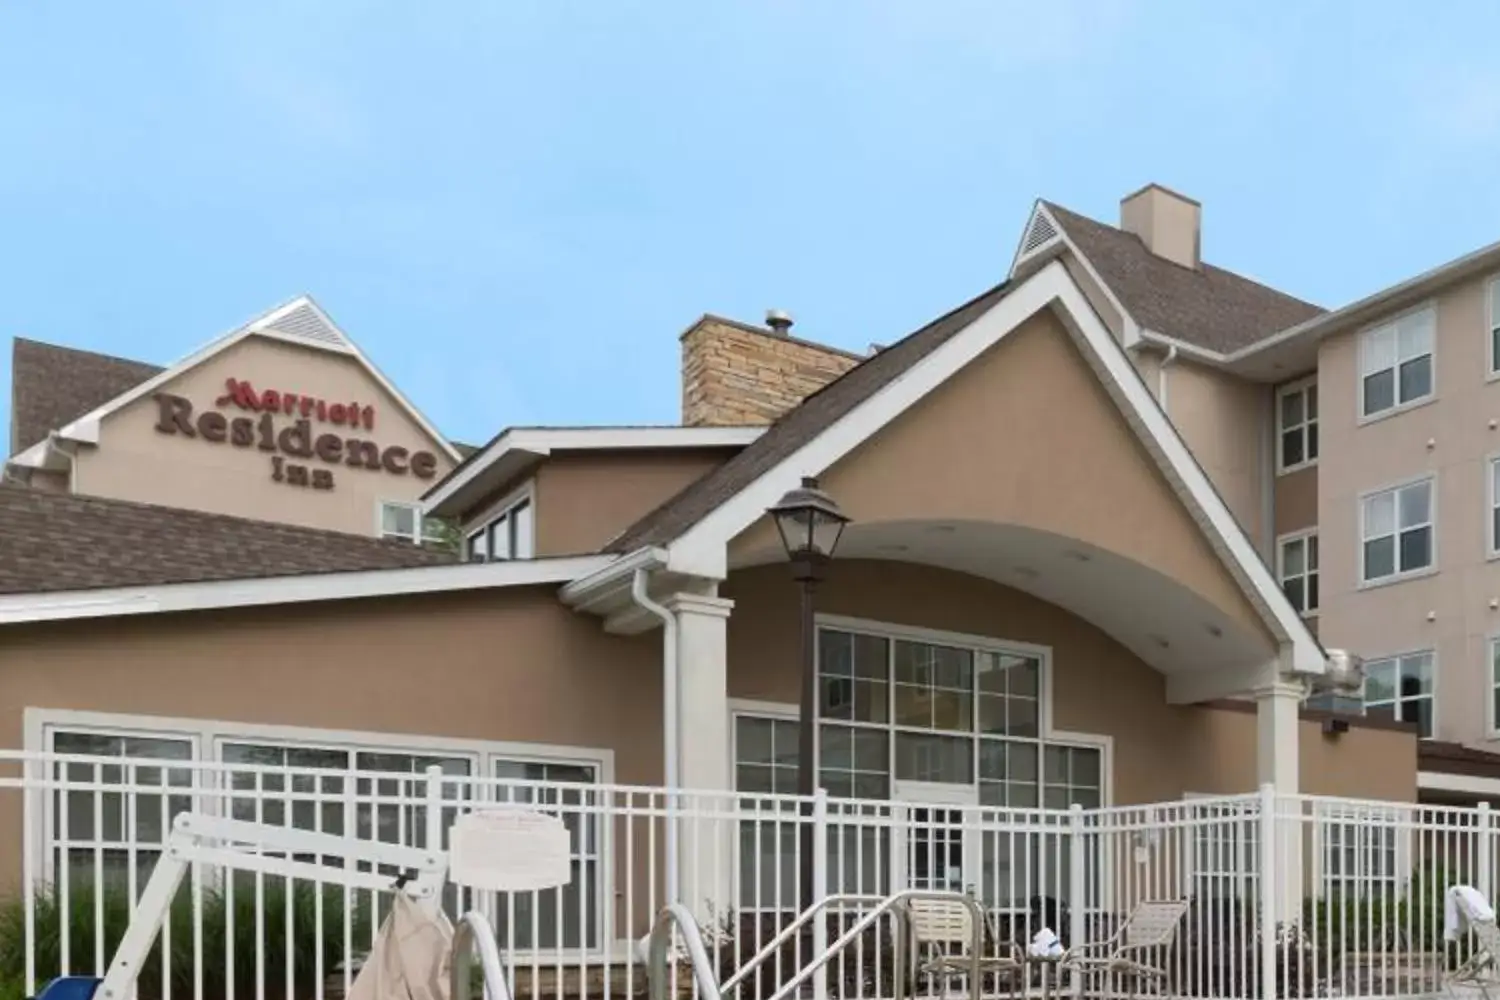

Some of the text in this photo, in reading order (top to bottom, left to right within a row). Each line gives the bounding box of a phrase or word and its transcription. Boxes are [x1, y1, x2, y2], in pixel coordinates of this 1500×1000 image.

[215, 377, 375, 430] Marriott
[152, 392, 437, 479] Residence
[271, 455, 334, 490] Inn
